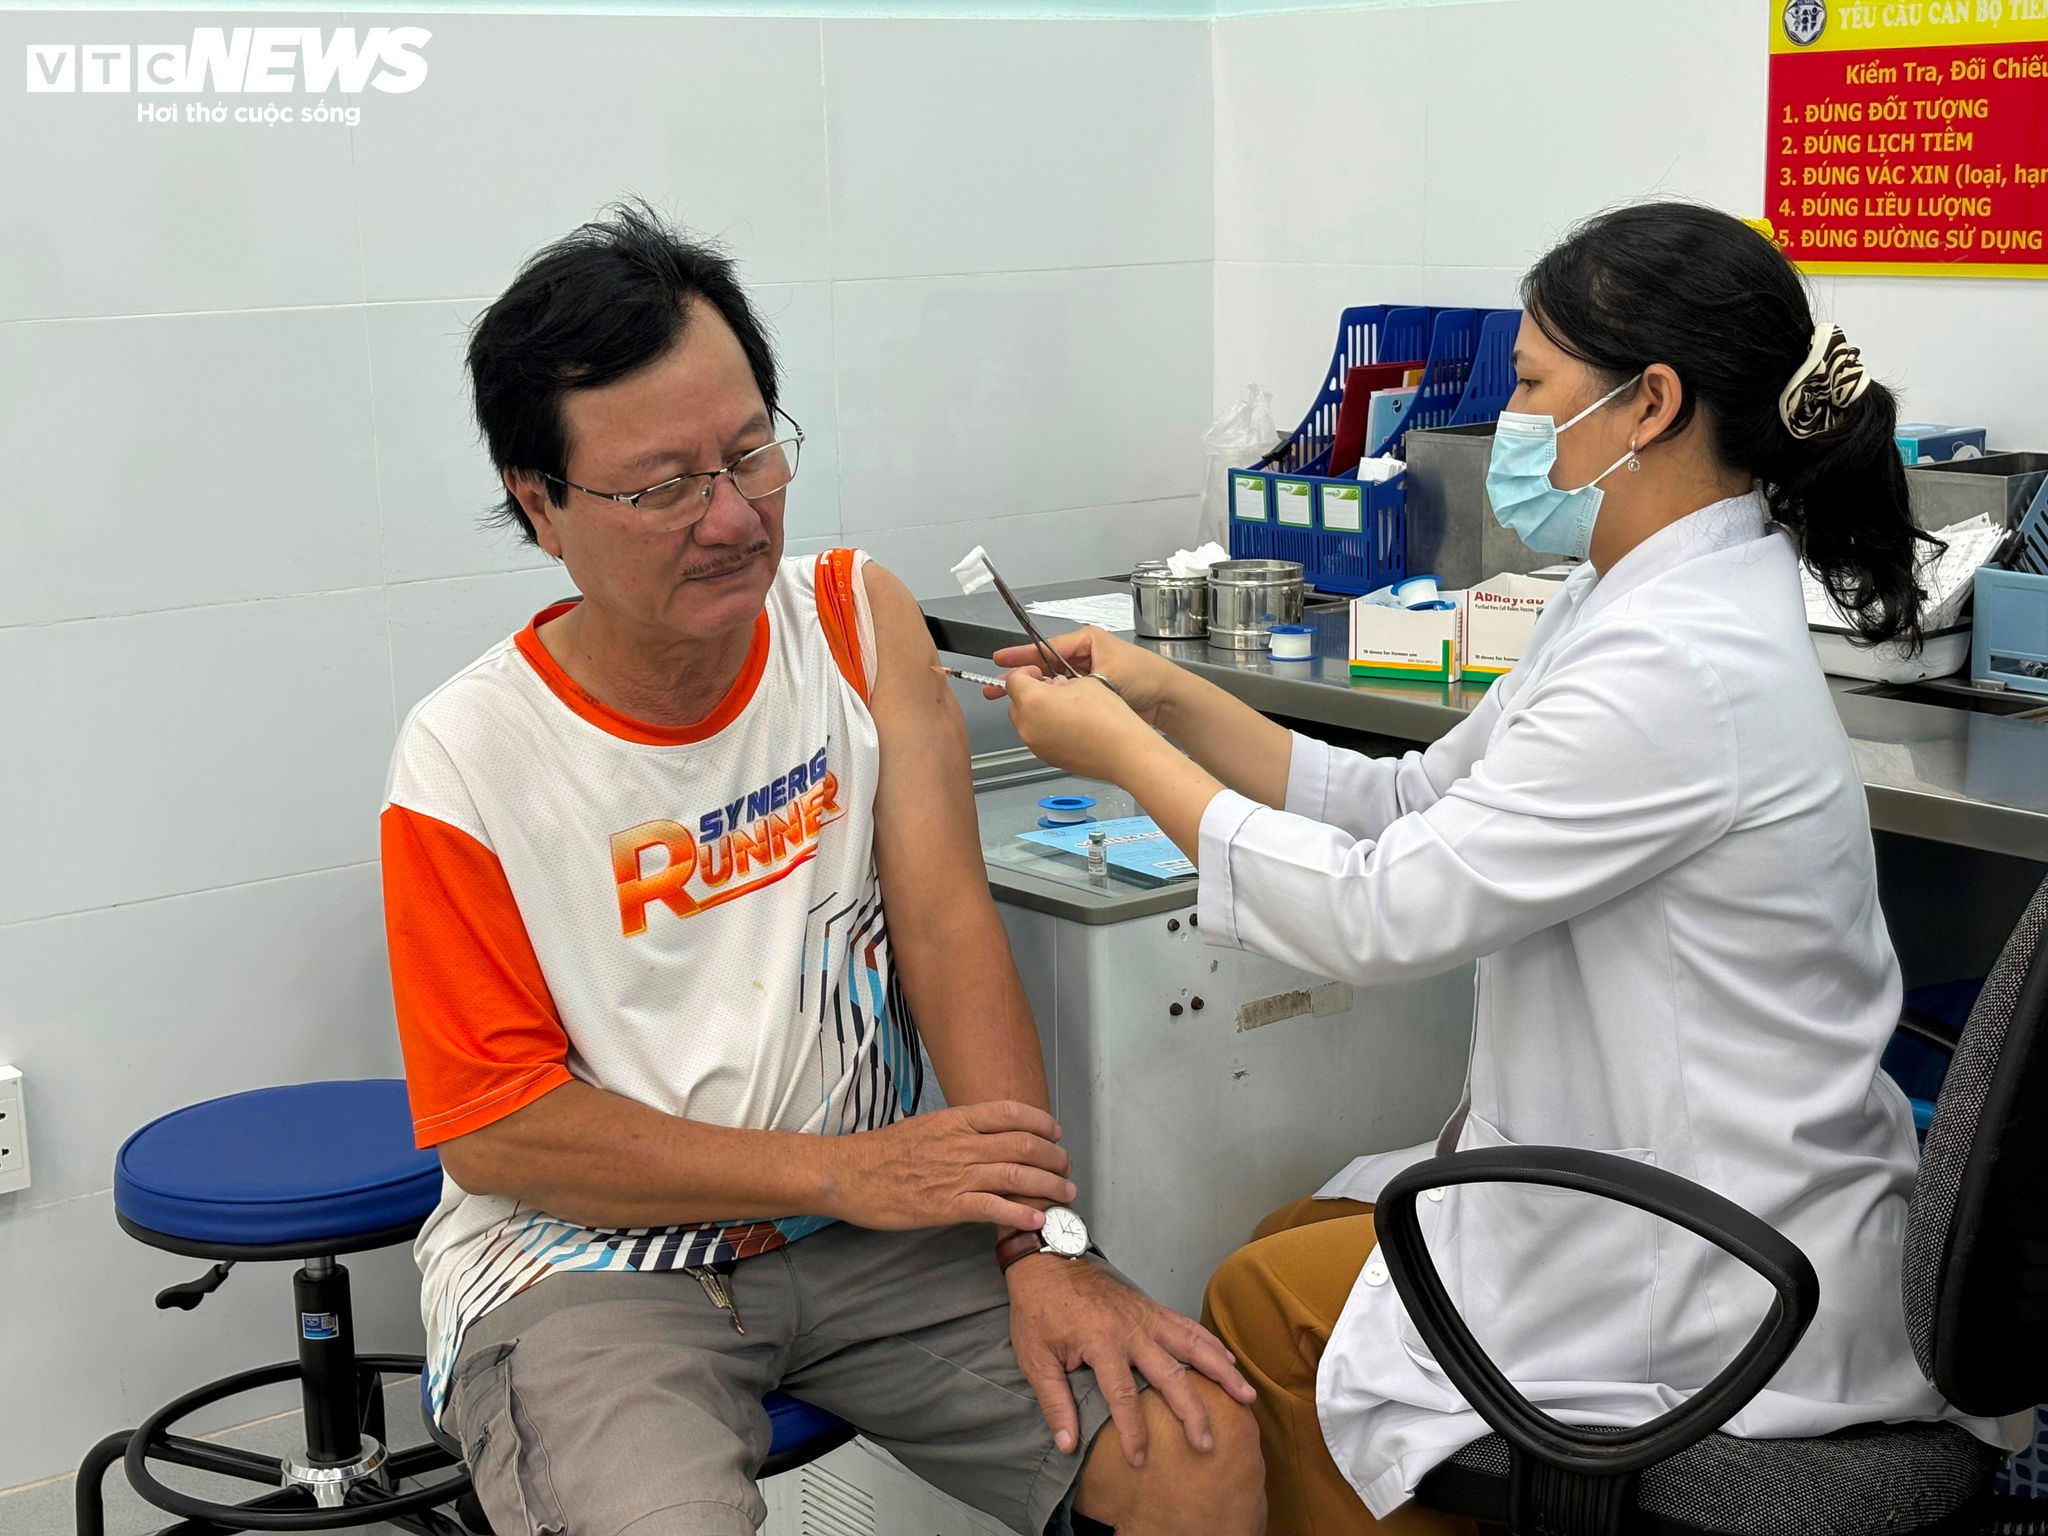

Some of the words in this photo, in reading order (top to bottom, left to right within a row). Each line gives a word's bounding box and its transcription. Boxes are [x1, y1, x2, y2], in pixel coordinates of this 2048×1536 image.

[1846, 59, 1897, 85] Kiểm
[1903, 62, 1944, 86] Tra,
[1950, 57, 1986, 81] Đối
[1783, 105, 1799, 124] 1.
[1804, 97, 1862, 123] ĐÚNG
[1868, 95, 1907, 121] ĐỐI
[1913, 97, 1989, 124] TƯỢNG
[1781, 136, 1798, 155] 2.
[1803, 129, 1861, 154] ĐÚNG
[1867, 133, 1914, 158] LỊCH
[1921, 126, 1973, 152] TIÊM
[1780, 167, 1797, 186] 3.
[1802, 160, 1860, 185] ĐÚNG
[1866, 159, 1905, 185] VÁC
[1911, 165, 1949, 185] XIN
[1955, 163, 2008, 189] (loại,
[1778, 199, 1796, 217] 4.
[1802, 192, 1859, 217] ĐÚNG
[1865, 191, 1911, 217] LIỀU
[1917, 194, 1992, 222] LƯỢNG
[1778, 230, 1794, 247] 5.
[1801, 223, 1857, 247] ĐÚNG
[1863, 224, 1939, 248] ĐƯỜNG
[1945, 224, 1976, 250] SỬ
[1981, 230, 2042, 254] DỤNG
[700, 735, 831, 843] SYNERG
[609, 770, 840, 938] RUNNER
